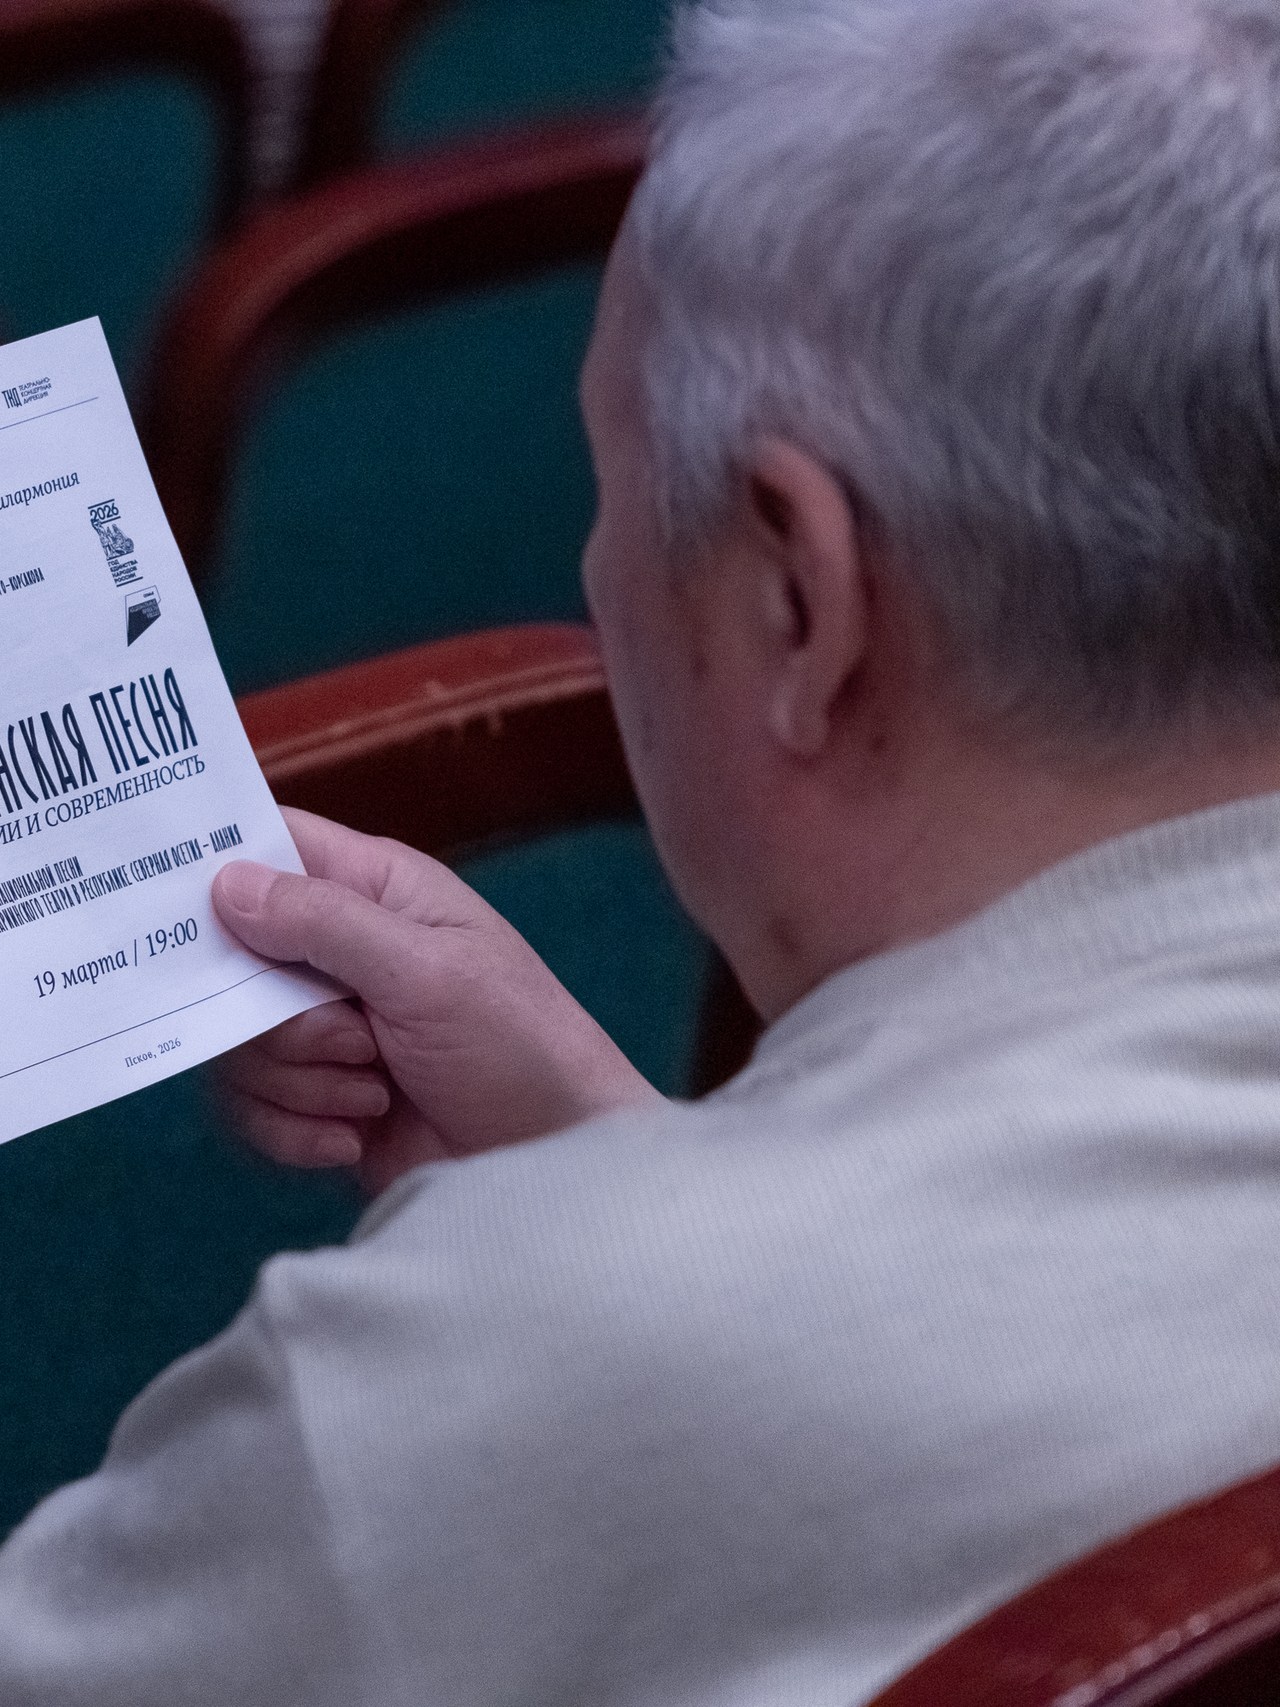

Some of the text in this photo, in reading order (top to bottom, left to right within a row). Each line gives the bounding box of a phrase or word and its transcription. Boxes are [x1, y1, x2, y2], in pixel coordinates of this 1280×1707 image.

[21, 383, 52, 397] КОНЦЕРТНАЯ
[23, 391, 49, 405] ДИРЕКЦИЯ
[89, 502, 119, 522] 2026
[89, 667, 198, 775] ПЕСНЯ
[25, 813, 42, 836] И
[44, 754, 206, 827] СОВРЕМЕННОСТЬ
[40, 886, 75, 915] ТЕАТРА
[71, 884, 81, 905] В
[79, 865, 133, 902] РЕСПУБЛИКЕ
[130, 850, 173, 882] СЕВЕРНАЯ
[171, 838, 203, 867] ОСЕТИЯ
[210, 823, 243, 853] АЛАНИЯ
[53, 856, 83, 884] ПЕСНИ
[34, 970, 56, 998] 19
[61, 949, 128, 989] марта
[145, 918, 198, 957] 19:00
[125, 1037, 182, 1068] Псков, 2026
